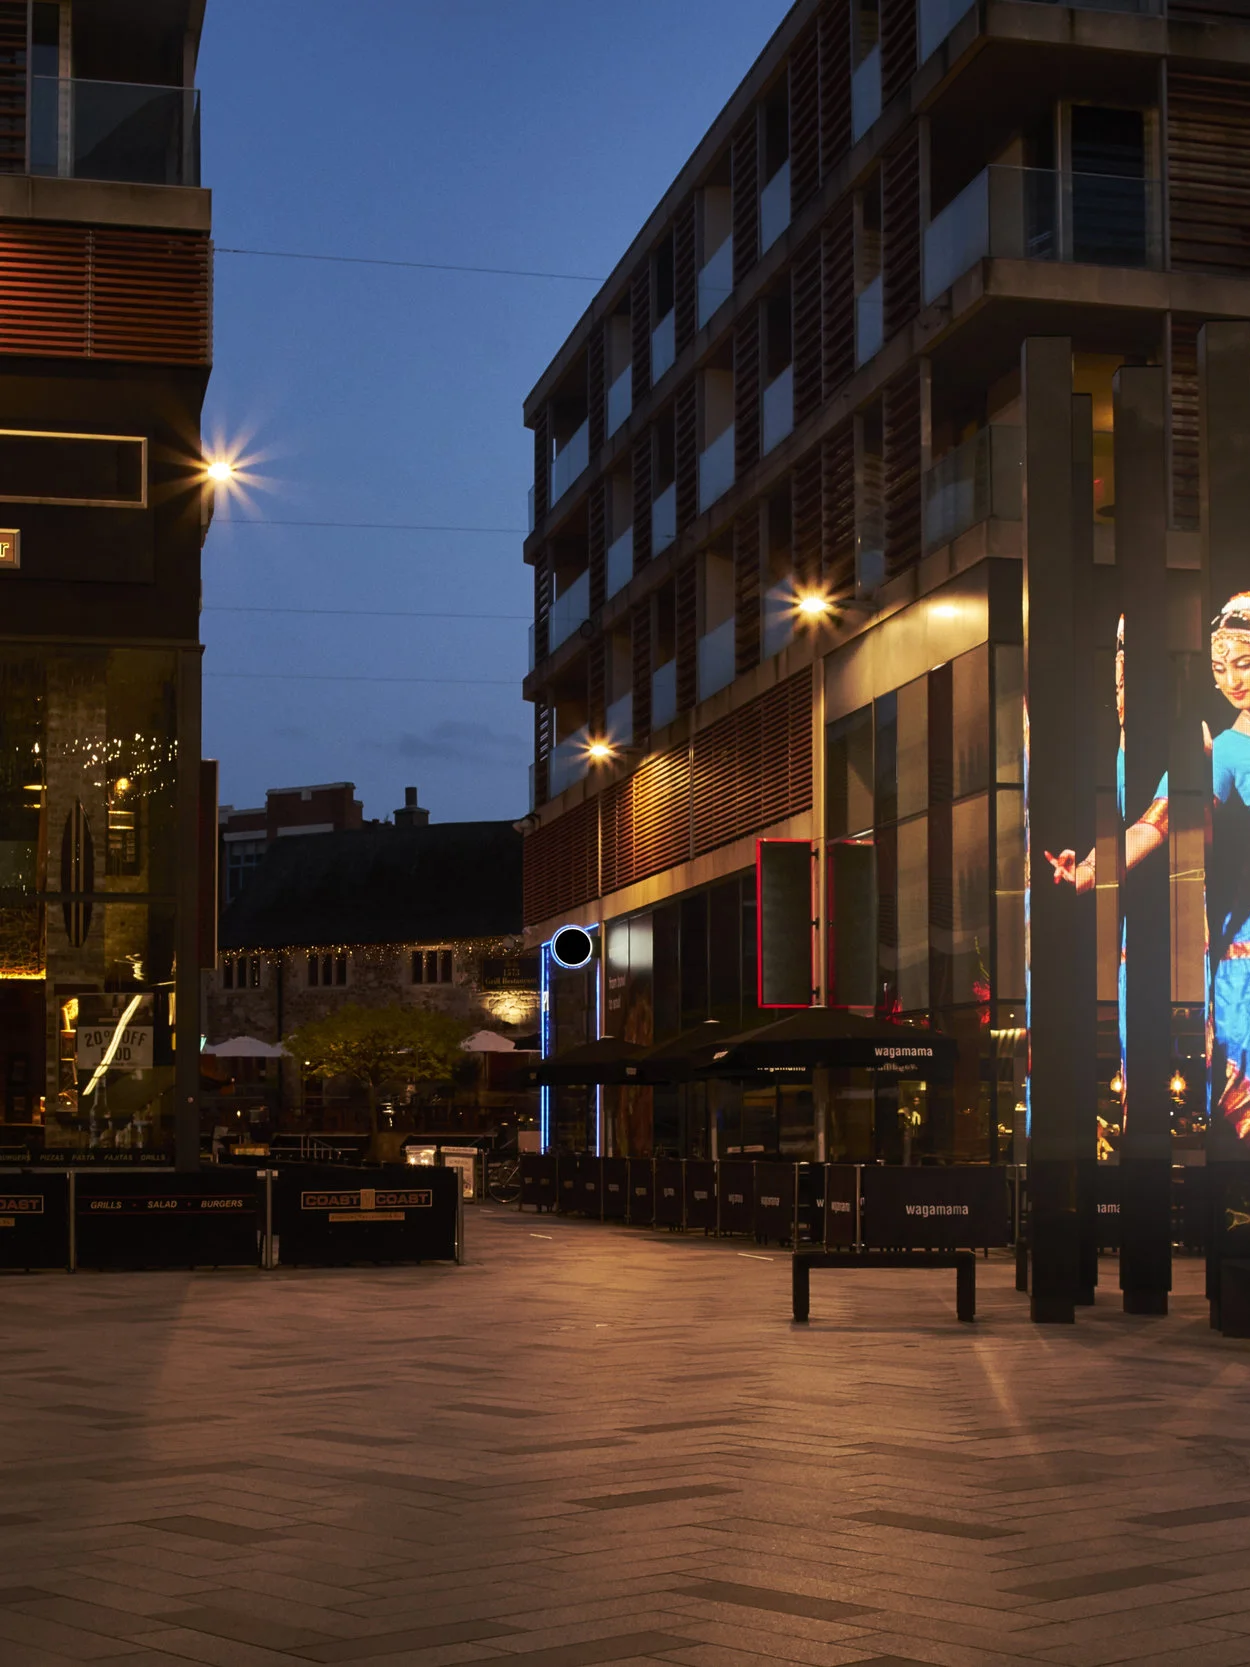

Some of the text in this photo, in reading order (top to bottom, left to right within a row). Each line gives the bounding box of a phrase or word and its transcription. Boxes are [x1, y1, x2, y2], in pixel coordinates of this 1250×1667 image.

[101, 1047, 131, 1061] FOD
[874, 1047, 933, 1059] wagamama
[0, 1199, 40, 1210] OAST
[90, 1199, 244, 1209] GRILLS SALAD BURGERS
[305, 1194, 359, 1206] COAST
[376, 1193, 429, 1205] COAST
[905, 1203, 969, 1218] wagamama
